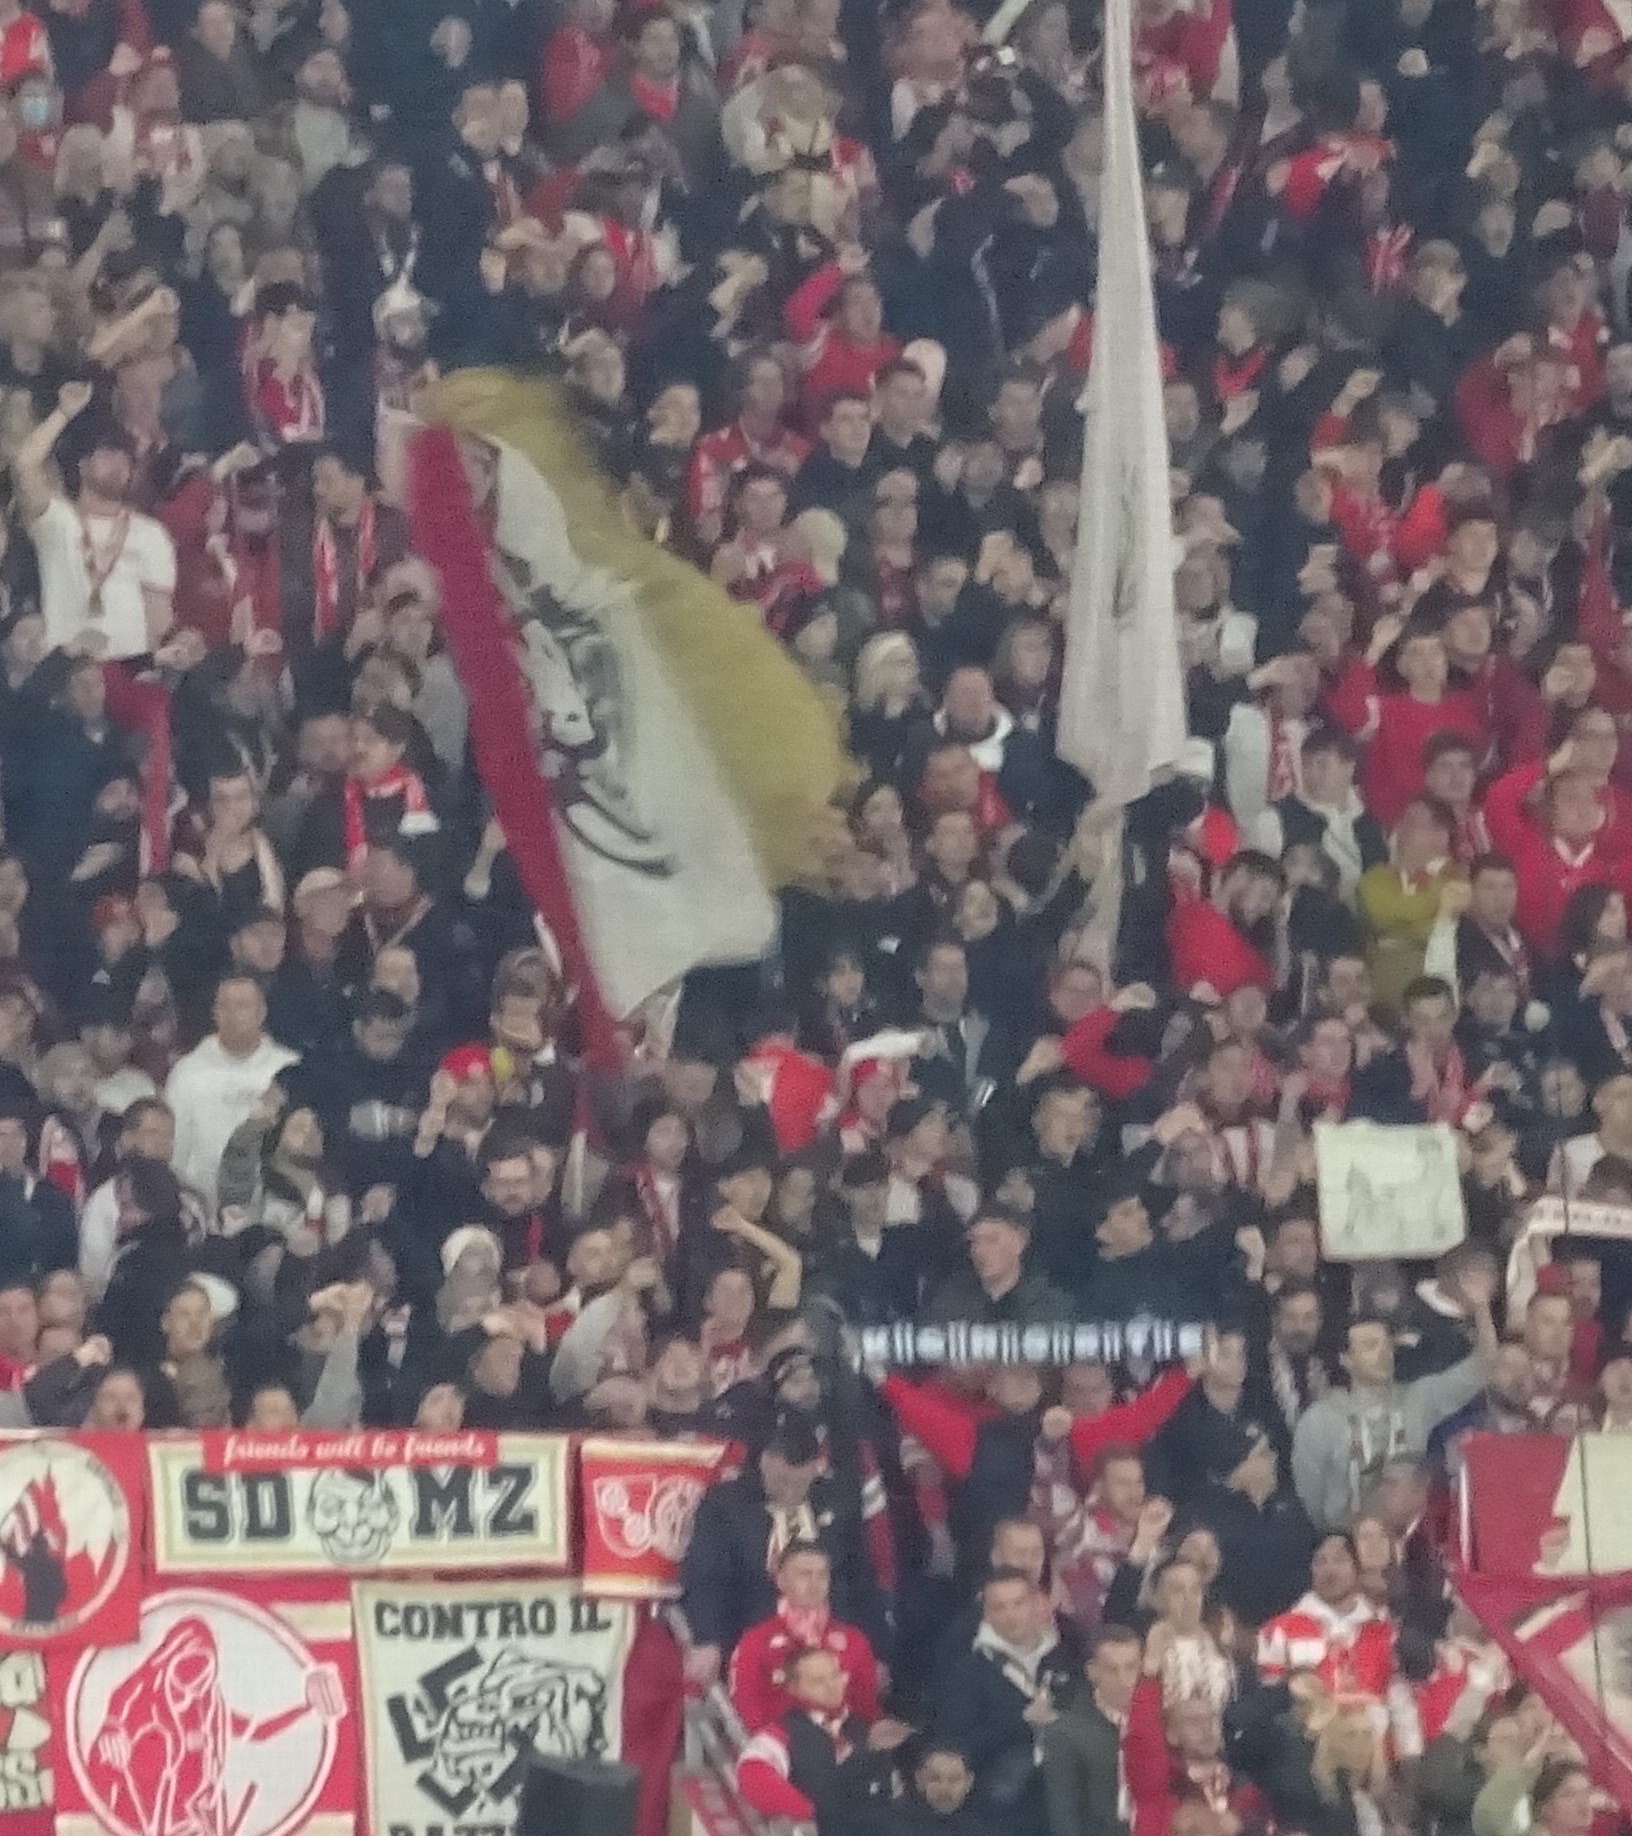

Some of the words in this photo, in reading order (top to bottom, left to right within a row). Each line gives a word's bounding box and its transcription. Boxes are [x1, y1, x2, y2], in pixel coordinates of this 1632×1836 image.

[222, 1434, 309, 1467] friends
[315, 1435, 365, 1459] will
[404, 1434, 486, 1464] friends
[185, 1470, 291, 1539] SD
[413, 1466, 538, 1538] MZ
[375, 1598, 556, 1640] CONTRO
